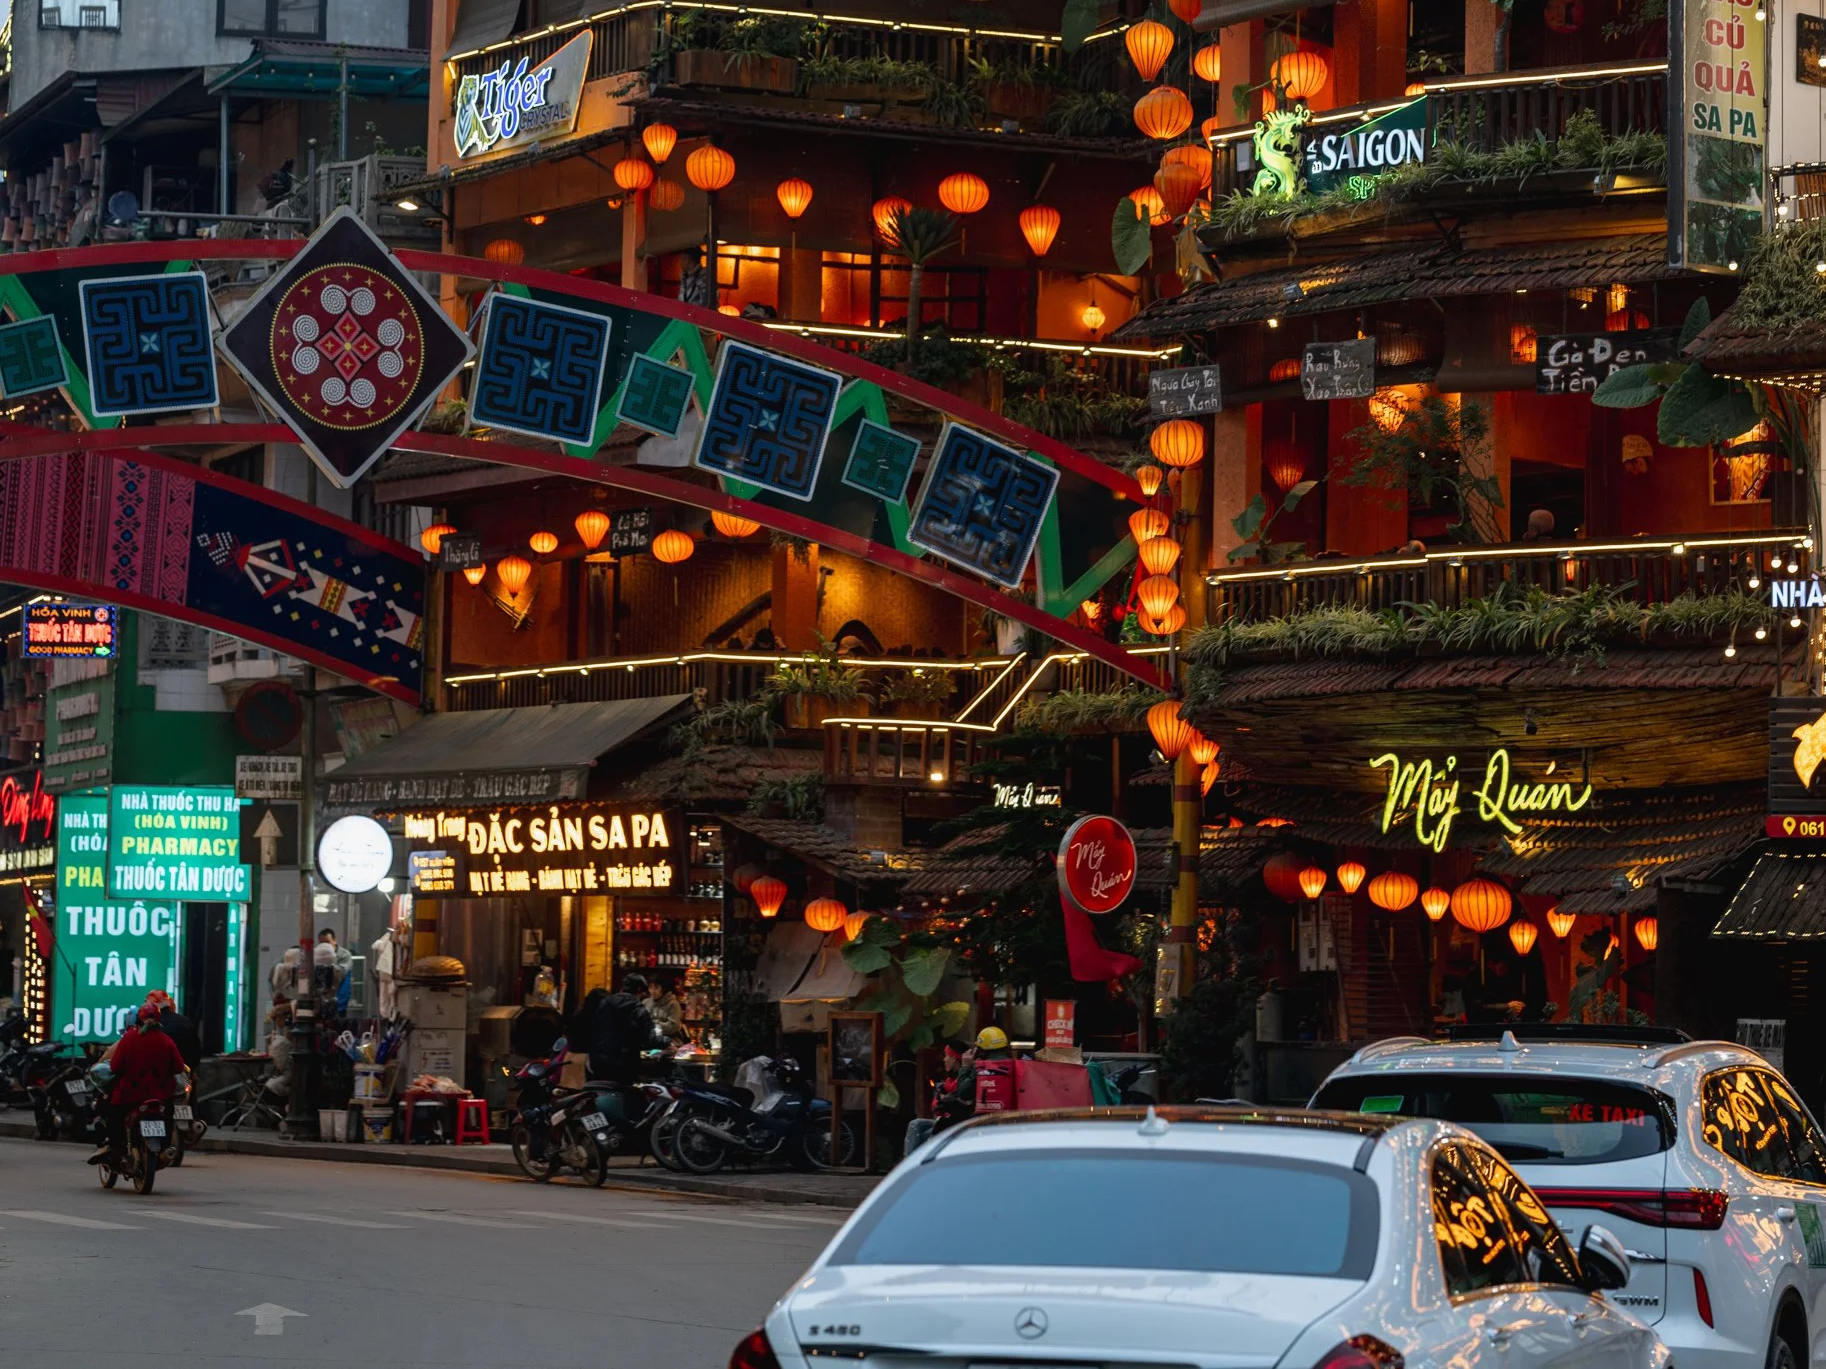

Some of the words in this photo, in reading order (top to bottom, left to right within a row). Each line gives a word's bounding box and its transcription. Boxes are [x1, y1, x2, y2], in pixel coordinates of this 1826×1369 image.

[1704, 15, 1745, 50] CỦ
[1694, 60, 1756, 97] QUẢ
[480, 56, 553, 139] Tiger
[519, 101, 568, 130] CRYSTAL
[1693, 102, 1723, 133] SA
[1729, 107, 1757, 139] PA
[1306, 139, 1324, 175] BIA
[1321, 127, 1426, 172] SAIGON
[1306, 352, 1329, 373] Rau
[1549, 339, 1583, 367] Gà
[1188, 393, 1218, 412] Xanh
[1772, 572, 1825, 608] NHÀ
[62, 609, 91, 618] VINH
[29, 646, 53, 654] GOOD
[54, 646, 94, 655] PHARMACY
[504, 774, 528, 796] GÁC
[1473, 748, 1593, 835] Quán
[122, 791, 148, 810] NHÀ
[152, 789, 194, 811] THUỐC
[196, 795, 221, 812] THU
[64, 810, 90, 829] NHÀ
[180, 815, 228, 831] VINH)
[121, 836, 239, 856] PHARMACY
[467, 813, 524, 865] ĐẶC
[529, 806, 584, 853] SẢN
[588, 815, 628, 850] SA
[631, 813, 669, 849] PA
[115, 857, 166, 891] THUỐC
[168, 861, 199, 892] TÂN
[203, 865, 245, 898] DƯỢC
[1091, 869, 1132, 899] Quán
[85, 951, 147, 987] TÂN
[1568, 1102, 1595, 1122] XE
[1600, 1104, 1645, 1128] TAXI
